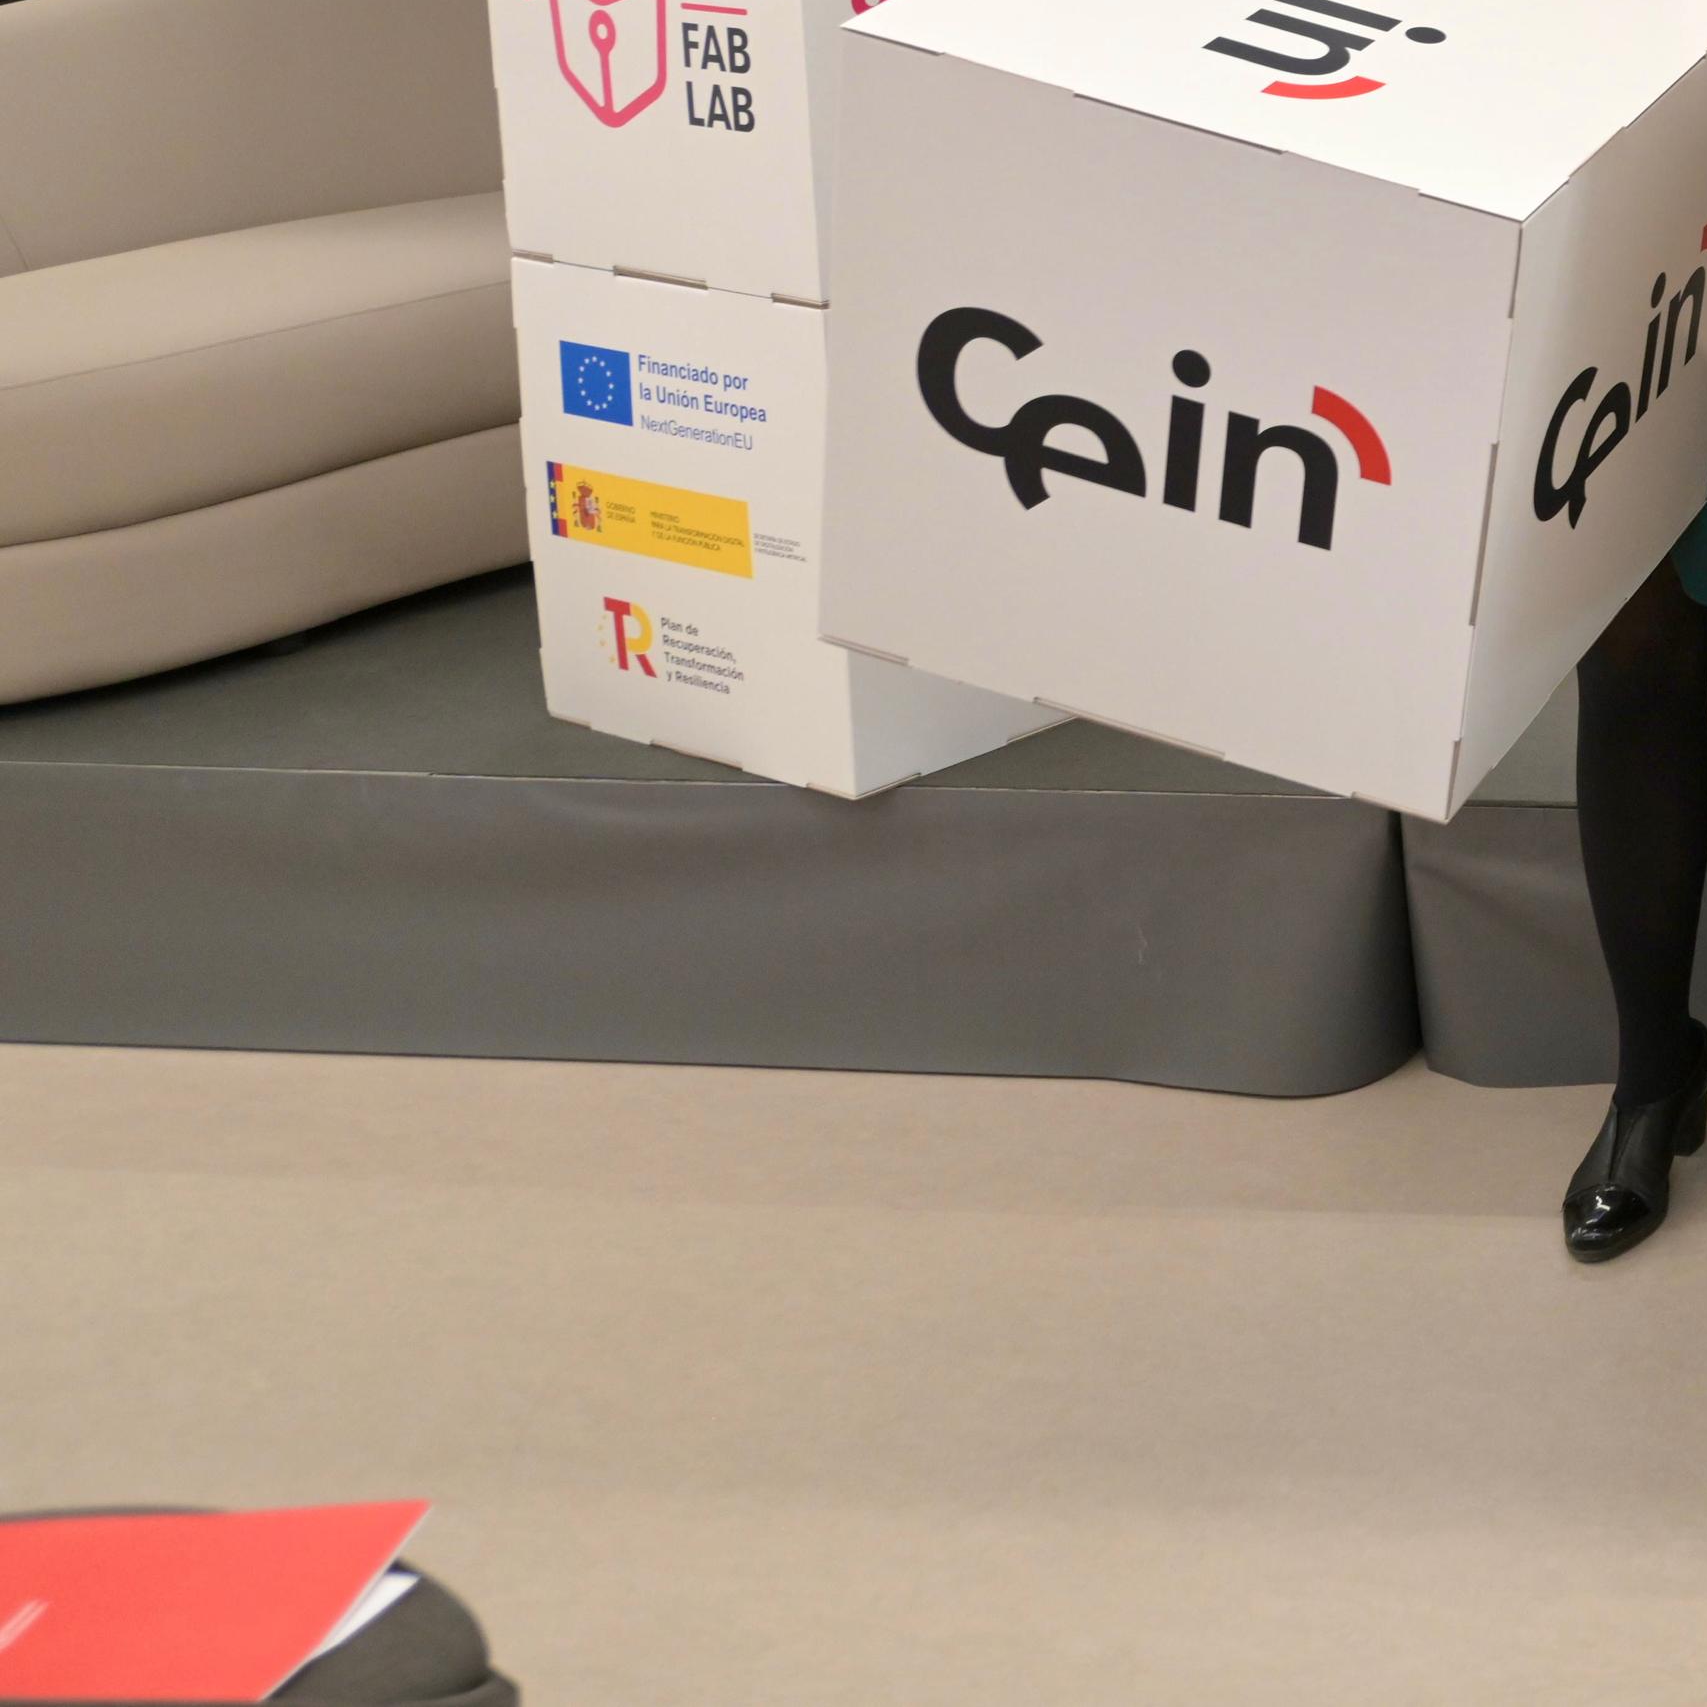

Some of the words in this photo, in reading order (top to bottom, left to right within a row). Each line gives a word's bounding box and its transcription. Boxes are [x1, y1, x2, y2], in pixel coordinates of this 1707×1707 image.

[682, 23, 751, 75] FAB
[685, 81, 755, 133] LAB
[638, 354, 718, 386] Financiado
[723, 374, 749, 392] por
[639, 382, 652, 401] la
[656, 384, 700, 411] Unión
[703, 394, 767, 423] Europea
[640, 415, 753, 451] NextGenerationEU
[660, 616, 683, 633] Plan
[685, 623, 699, 637] de
[662, 634, 737, 665] Recuperación,
[664, 650, 745, 682] Transformación
[666, 670, 672, 683] y
[674, 670, 731, 695] Resiliencia
